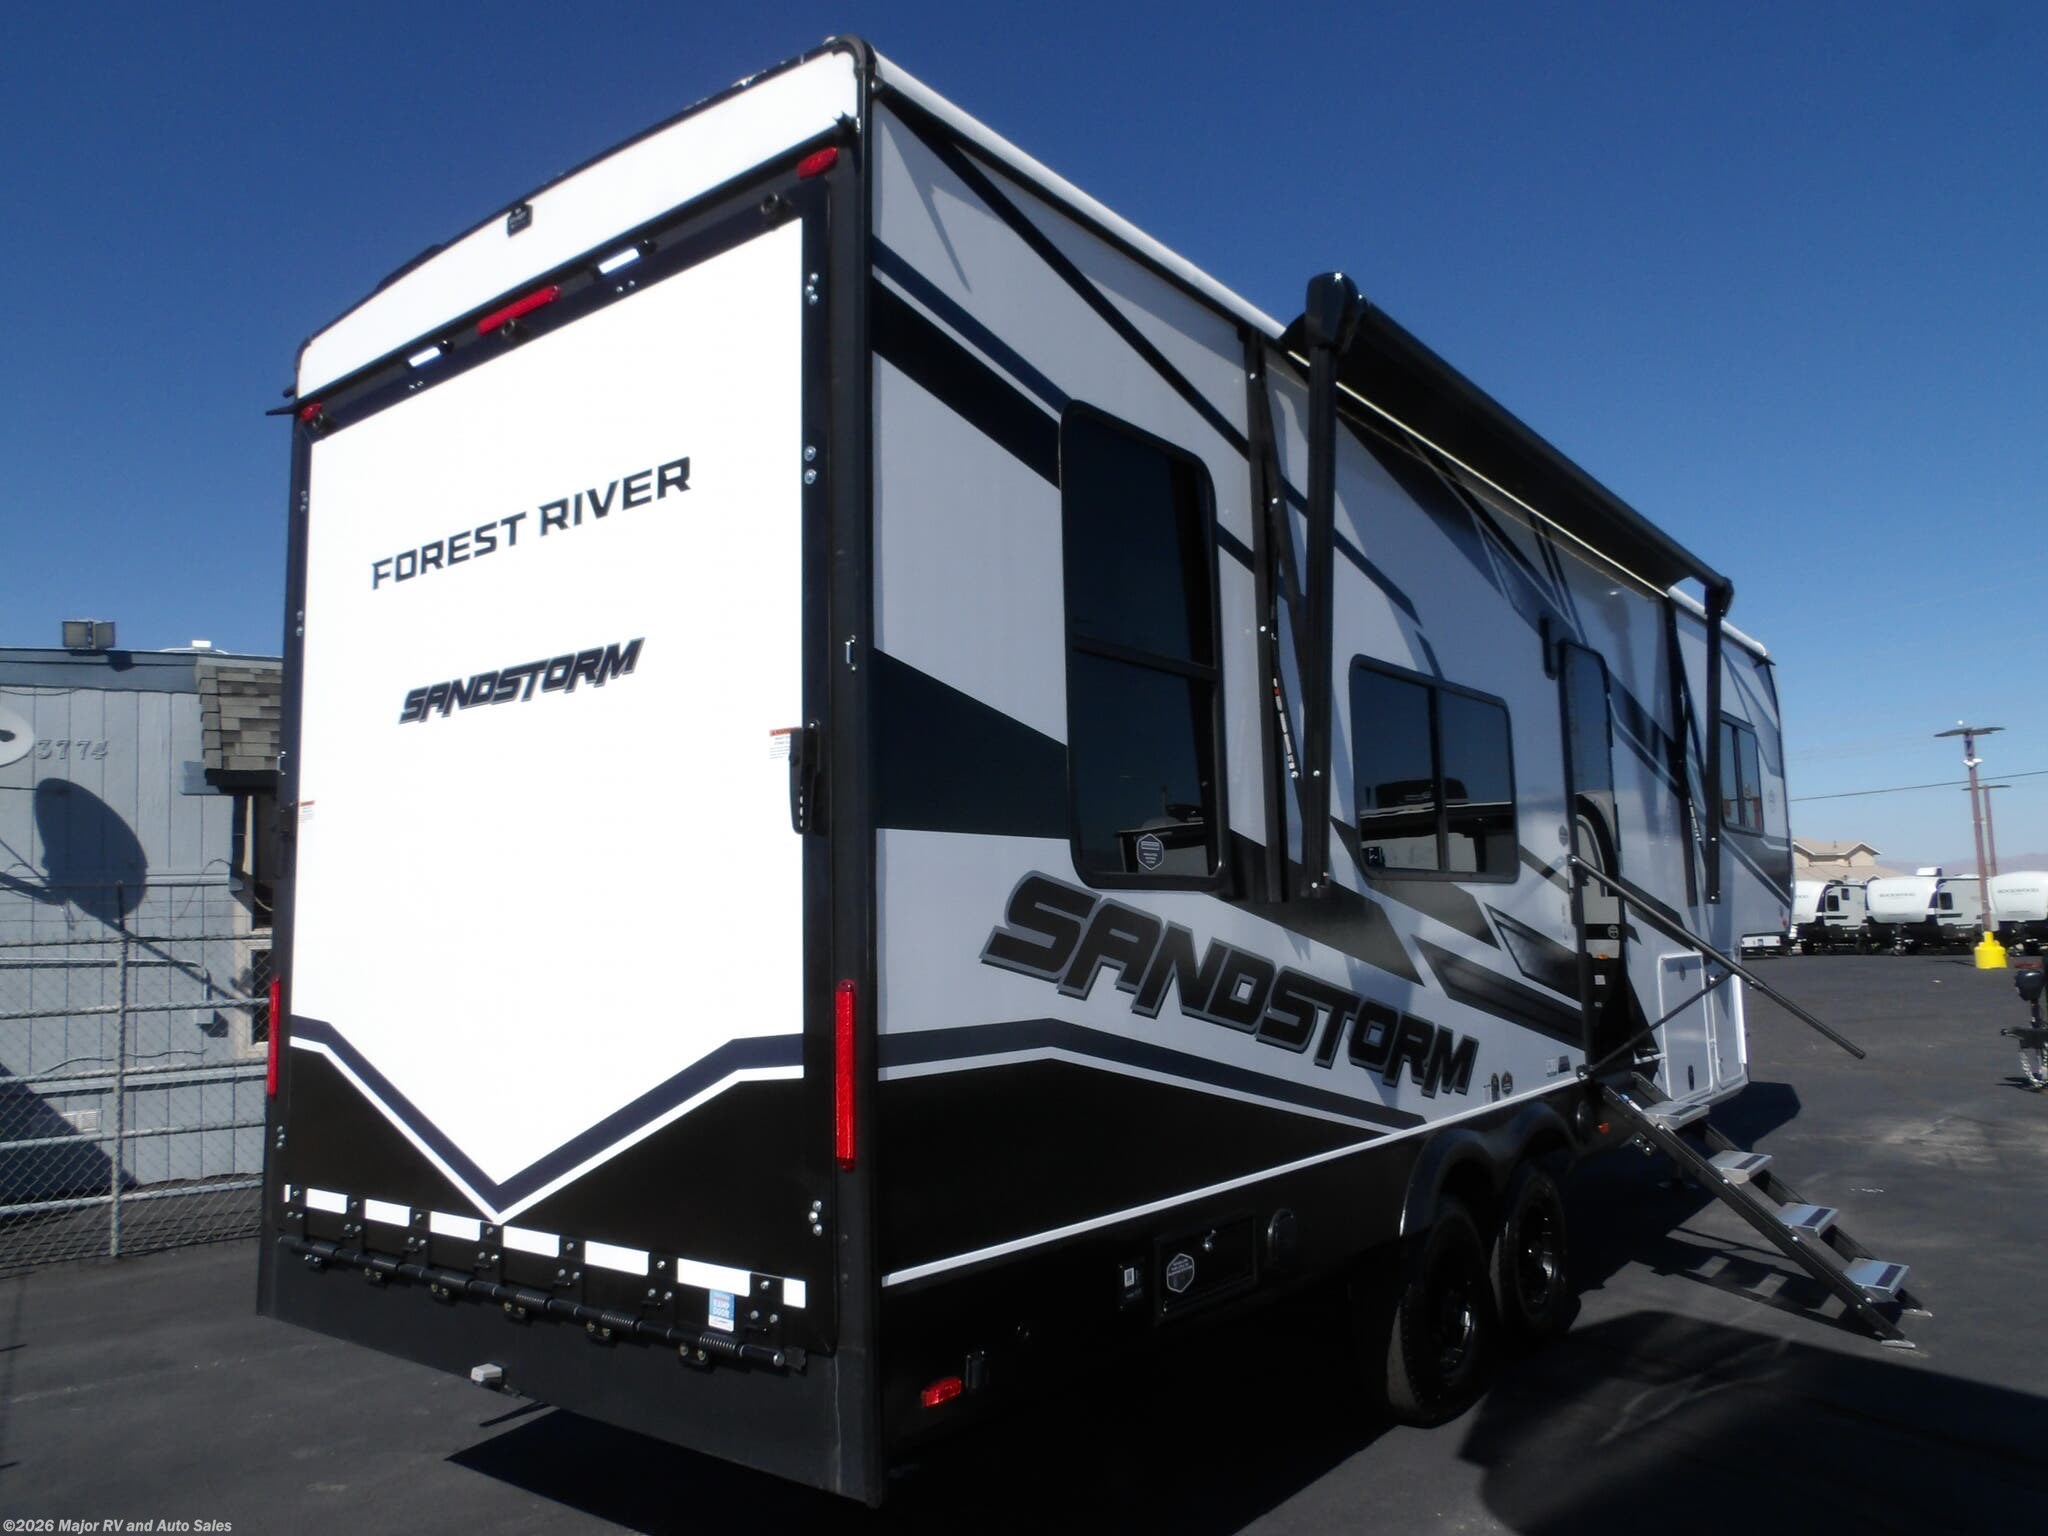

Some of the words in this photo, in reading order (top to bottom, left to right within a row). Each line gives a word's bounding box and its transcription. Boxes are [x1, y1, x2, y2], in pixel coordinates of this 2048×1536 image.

[372, 511, 527, 590] FOREST
[538, 456, 691, 537] RIVER
[398, 636, 646, 725] SANDSTORM
[978, 869, 1480, 1098] SANDSTORM
